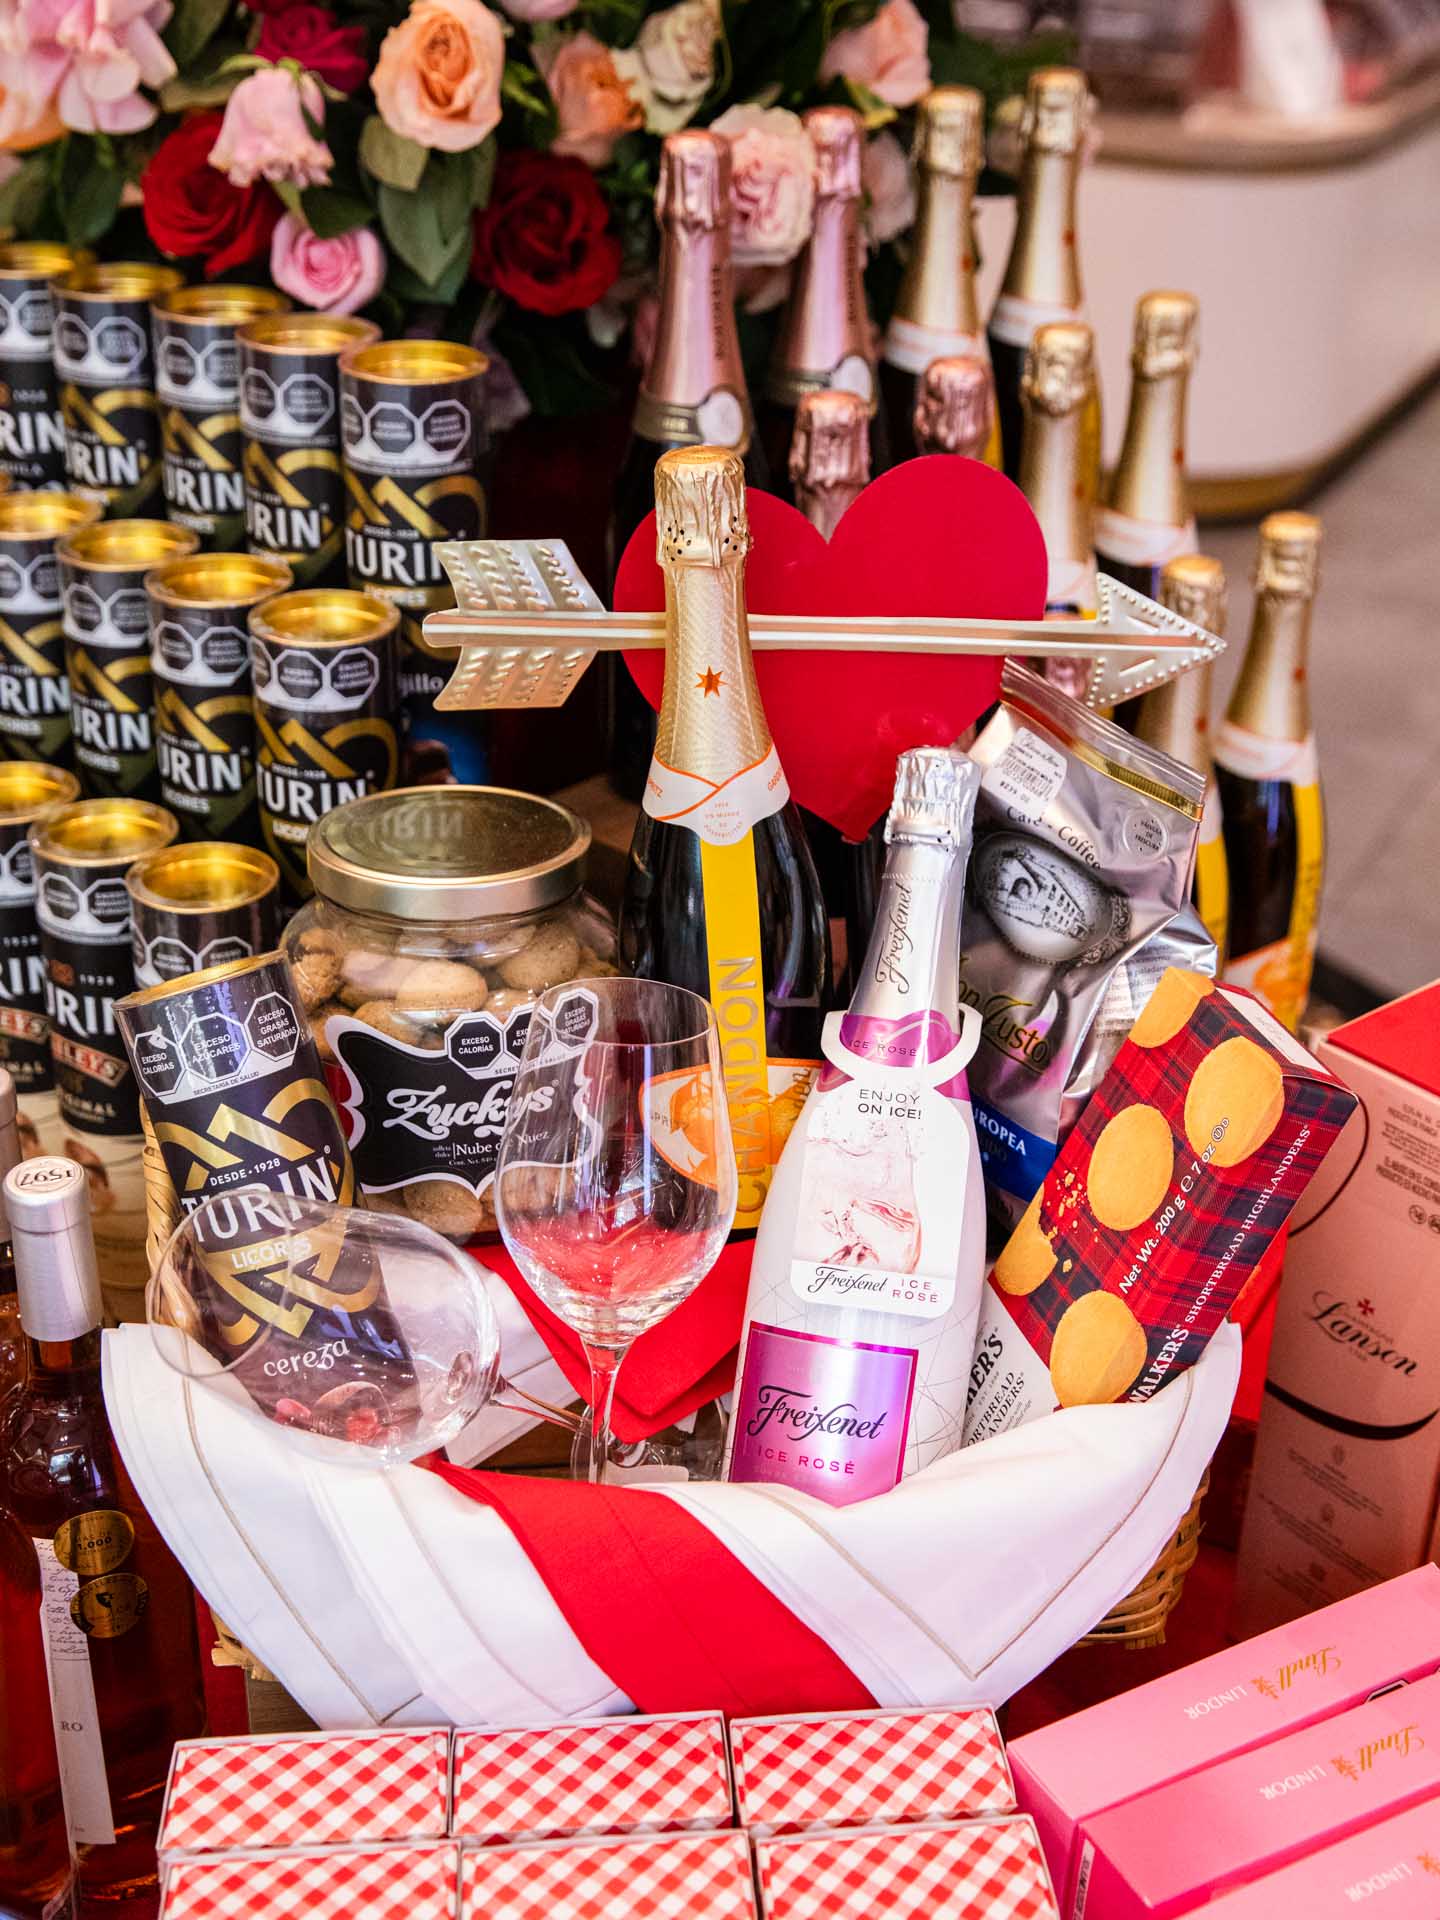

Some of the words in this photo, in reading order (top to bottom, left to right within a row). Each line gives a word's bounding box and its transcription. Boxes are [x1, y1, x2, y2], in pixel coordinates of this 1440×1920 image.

[1058, 826, 1101, 870] Coffee
[874, 882, 914, 994] Freixenet
[257, 1008, 286, 1026] EXCESO
[564, 1006, 586, 1021] EXCESO
[257, 1026, 298, 1049] SATURADAS
[260, 1018, 290, 1036] GRASAS
[192, 1042, 241, 1064] AZÚCARES
[194, 1034, 231, 1053] EXCESO
[458, 1044, 494, 1056] CALORÍAS
[461, 1036, 491, 1047] EXCESO
[849, 1039, 869, 1051] ICE
[141, 1052, 167, 1065] EXCESO
[142, 1062, 175, 1075] CALORÍAS
[716, 956, 768, 1213] CHANDON
[859, 1087, 921, 1105] ENJOY
[857, 1102, 884, 1117] ON
[888, 1105, 923, 1121] ICE!
[455, 1143, 493, 1156] Nube
[20, 1167, 73, 1186] 1597
[210, 1168, 248, 1187] DESDE
[253, 1158, 282, 1175] 1928
[181, 1156, 338, 1243] TURIN
[1119, 1263, 1142, 1295] Net
[1136, 1236, 1160, 1264] Wt.
[1155, 1205, 1176, 1235] 200
[1173, 1191, 1187, 1211] g
[1191, 1161, 1204, 1176] 7
[1202, 1144, 1216, 1164] oz
[1184, 1231, 1246, 1324] SHORTBREAD
[1241, 1127, 1311, 1232] HIGHLANDERS
[806, 1265, 889, 1296] Freixenet
[900, 1279, 933, 1292] ICE
[1310, 1290, 1418, 1376] Lanson
[263, 1337, 351, 1378] cereza
[747, 1385, 888, 1442] Freixenet
[759, 1445, 788, 1463] ICE
[798, 1453, 856, 1475] ROSÉ
[1183, 1684, 1249, 1721] LINDOR
[1260, 1764, 1328, 1802] LINDOR
[1344, 1862, 1414, 1903] LINDOR
